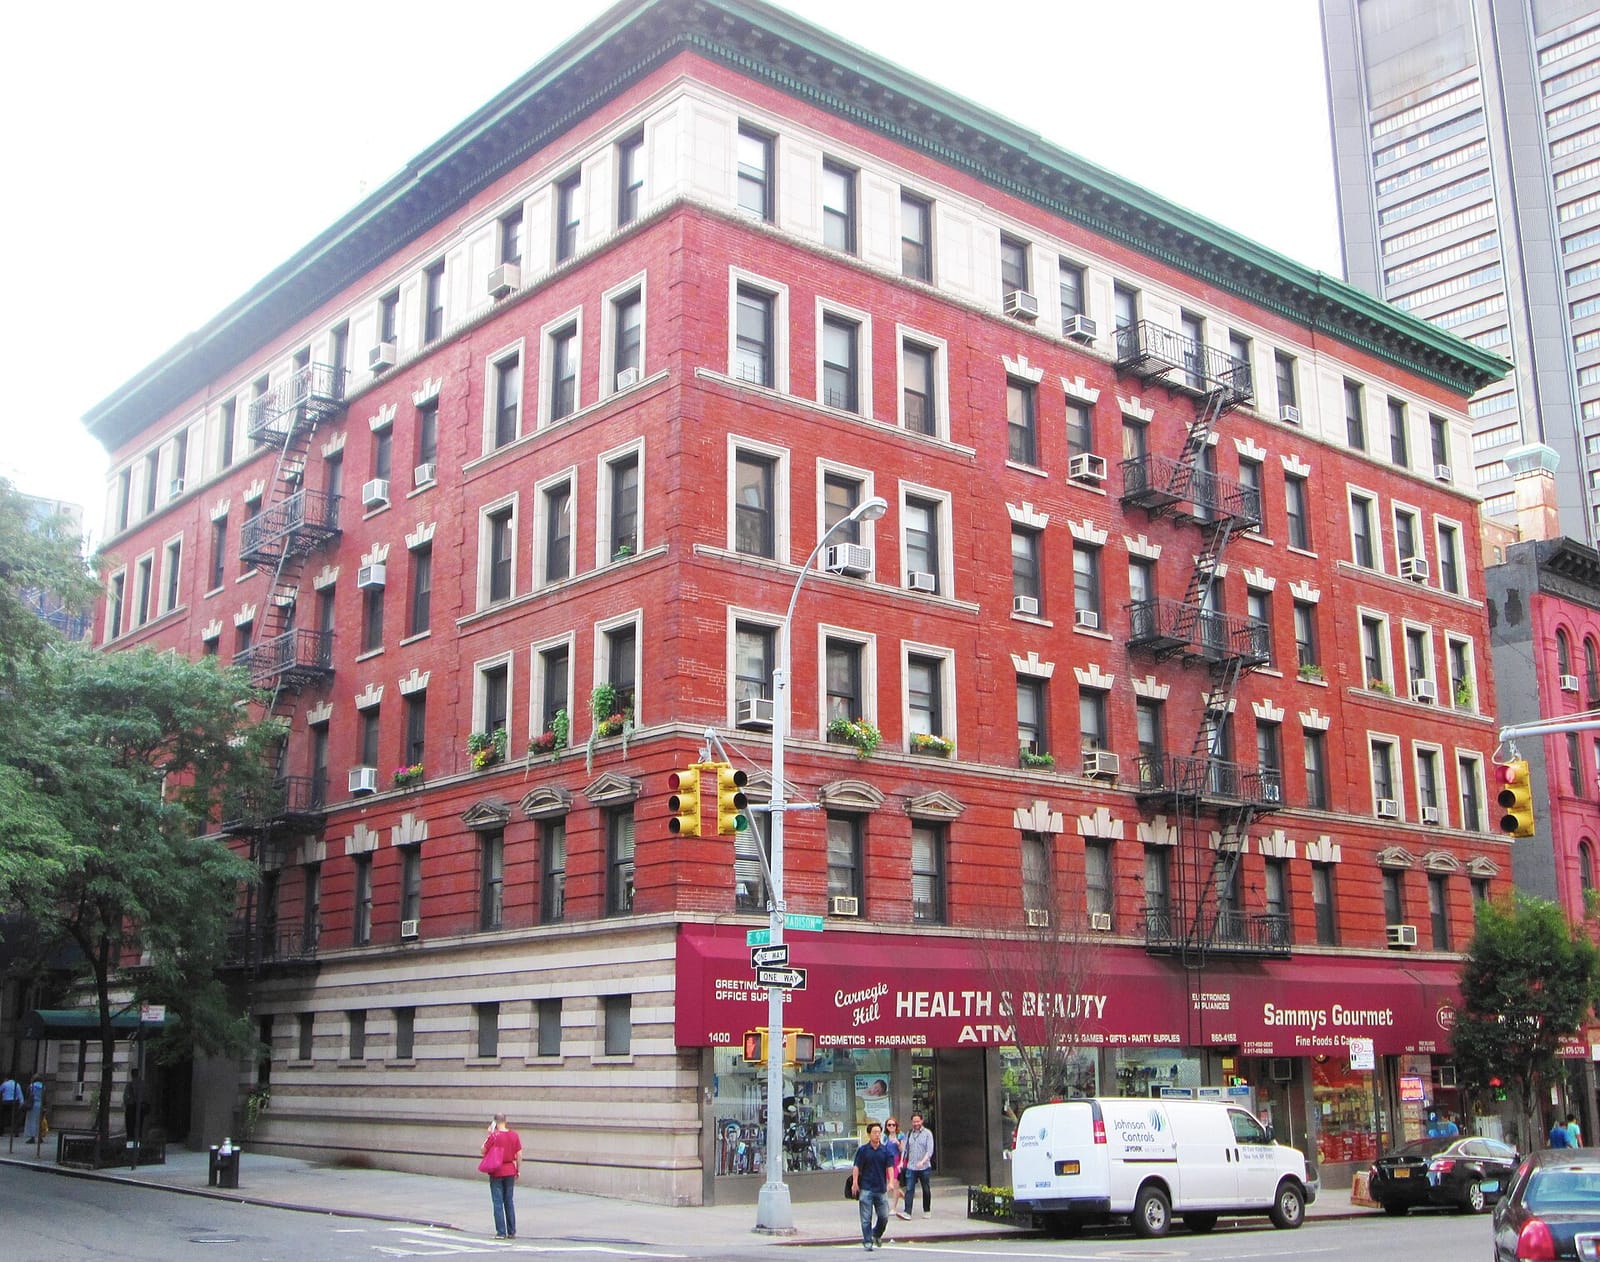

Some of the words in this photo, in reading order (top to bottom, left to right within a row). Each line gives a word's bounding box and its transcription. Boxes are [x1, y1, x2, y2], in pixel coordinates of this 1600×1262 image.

[785, 915, 815, 928] MADISON
[757, 953, 768, 962] ONE
[772, 951, 784, 960] WAY
[763, 972, 777, 982] ONE
[784, 974, 798, 984] WAY
[715, 990, 748, 1001] OFFICE
[751, 991, 793, 1003] SUPES
[834, 982, 889, 1008] Carnegie
[896, 991, 992, 1018] HEALTH
[998, 991, 1014, 1017] &
[1022, 991, 1107, 1019] BEAUTY
[851, 1003, 881, 1027] Hill
[1264, 1003, 1327, 1031] Sammys
[1332, 1004, 1394, 1026] Gourmet
[708, 1032, 731, 1043] 1400
[819, 1034, 866, 1045] COSMETICS
[874, 1035, 927, 1045] FRAGRANCES
[958, 1024, 1017, 1043] ATM
[1081, 1033, 1104, 1043] GAMES
[1109, 1034, 1127, 1043] GIFTS
[1131, 1034, 1152, 1043] PARTY
[1153, 1034, 1181, 1043] SUPPLIES
[1295, 1035, 1311, 1046] Fine
[1312, 1035, 1332, 1046] Foods
[1333, 1035, 1340, 1046] &
[1113, 1119, 1146, 1130] Johnson
[1122, 1131, 1155, 1143] Controls
